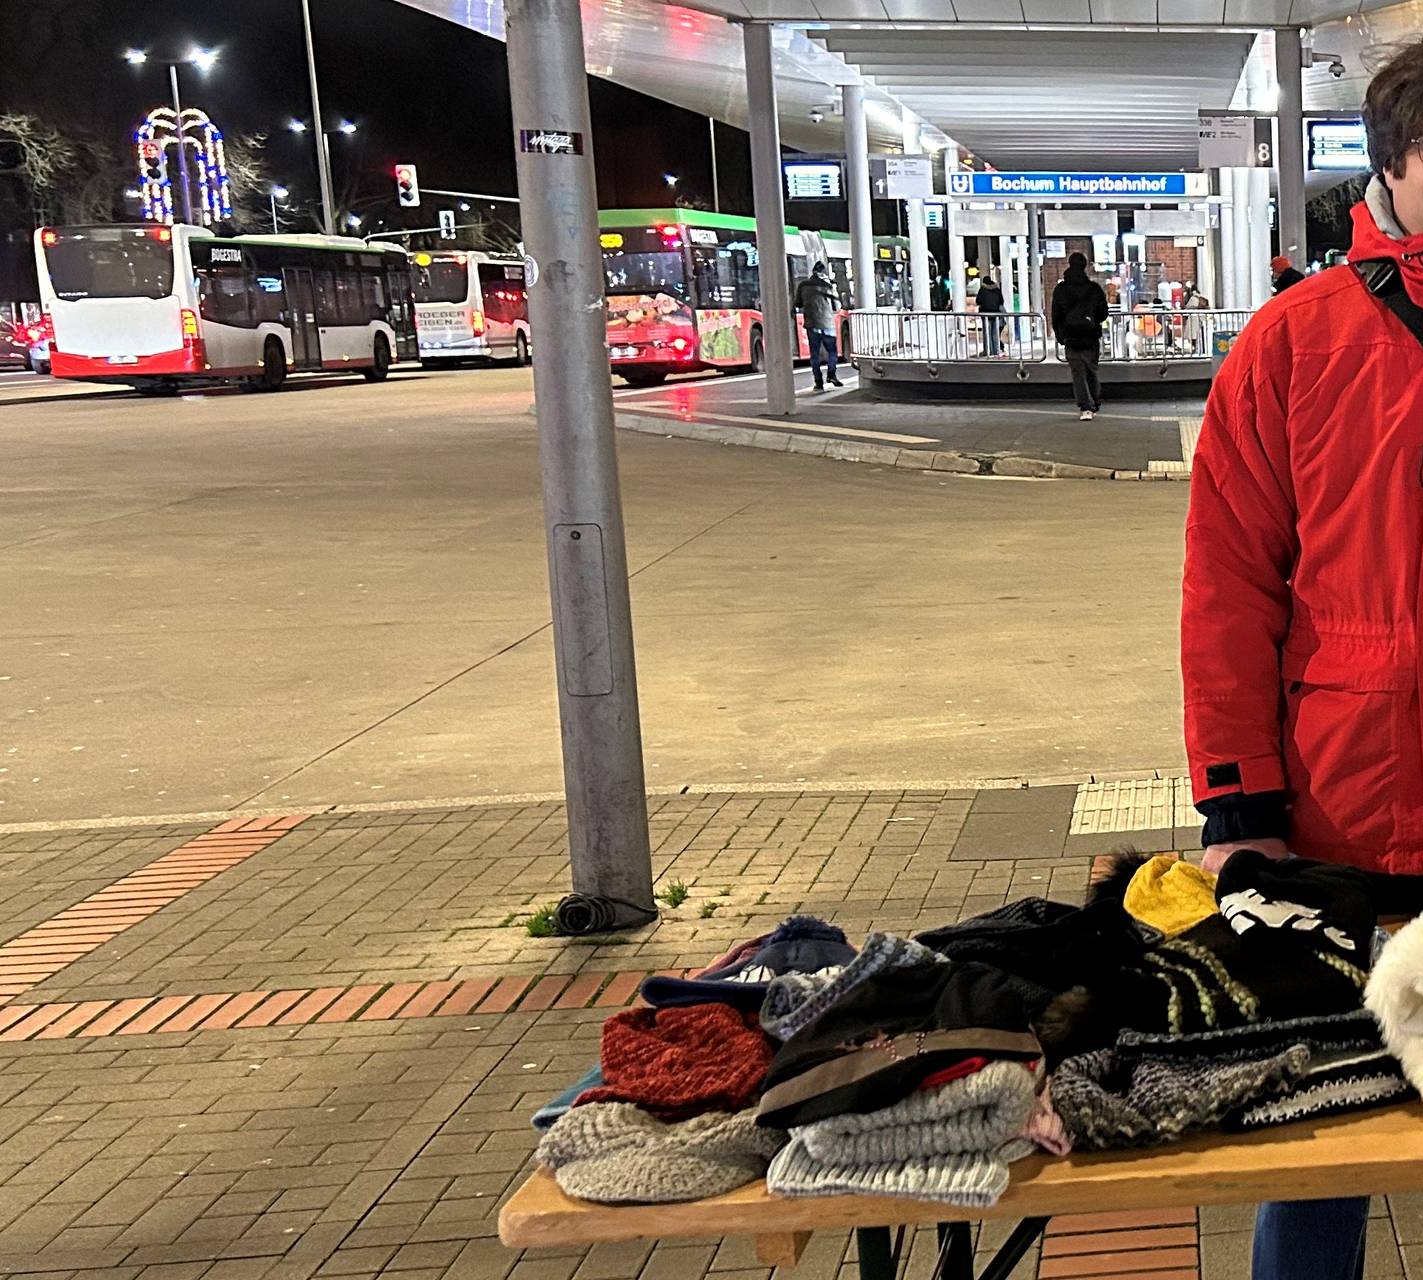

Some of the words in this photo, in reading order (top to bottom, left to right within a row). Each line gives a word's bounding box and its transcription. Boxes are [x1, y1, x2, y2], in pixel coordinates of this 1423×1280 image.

[1258, 143, 1270, 161] 8
[876, 178, 884, 194] 1
[991, 176, 1055, 191] Bochum
[1059, 176, 1167, 194] Hauptbahnhof
[1210, 215, 1217, 226] 7
